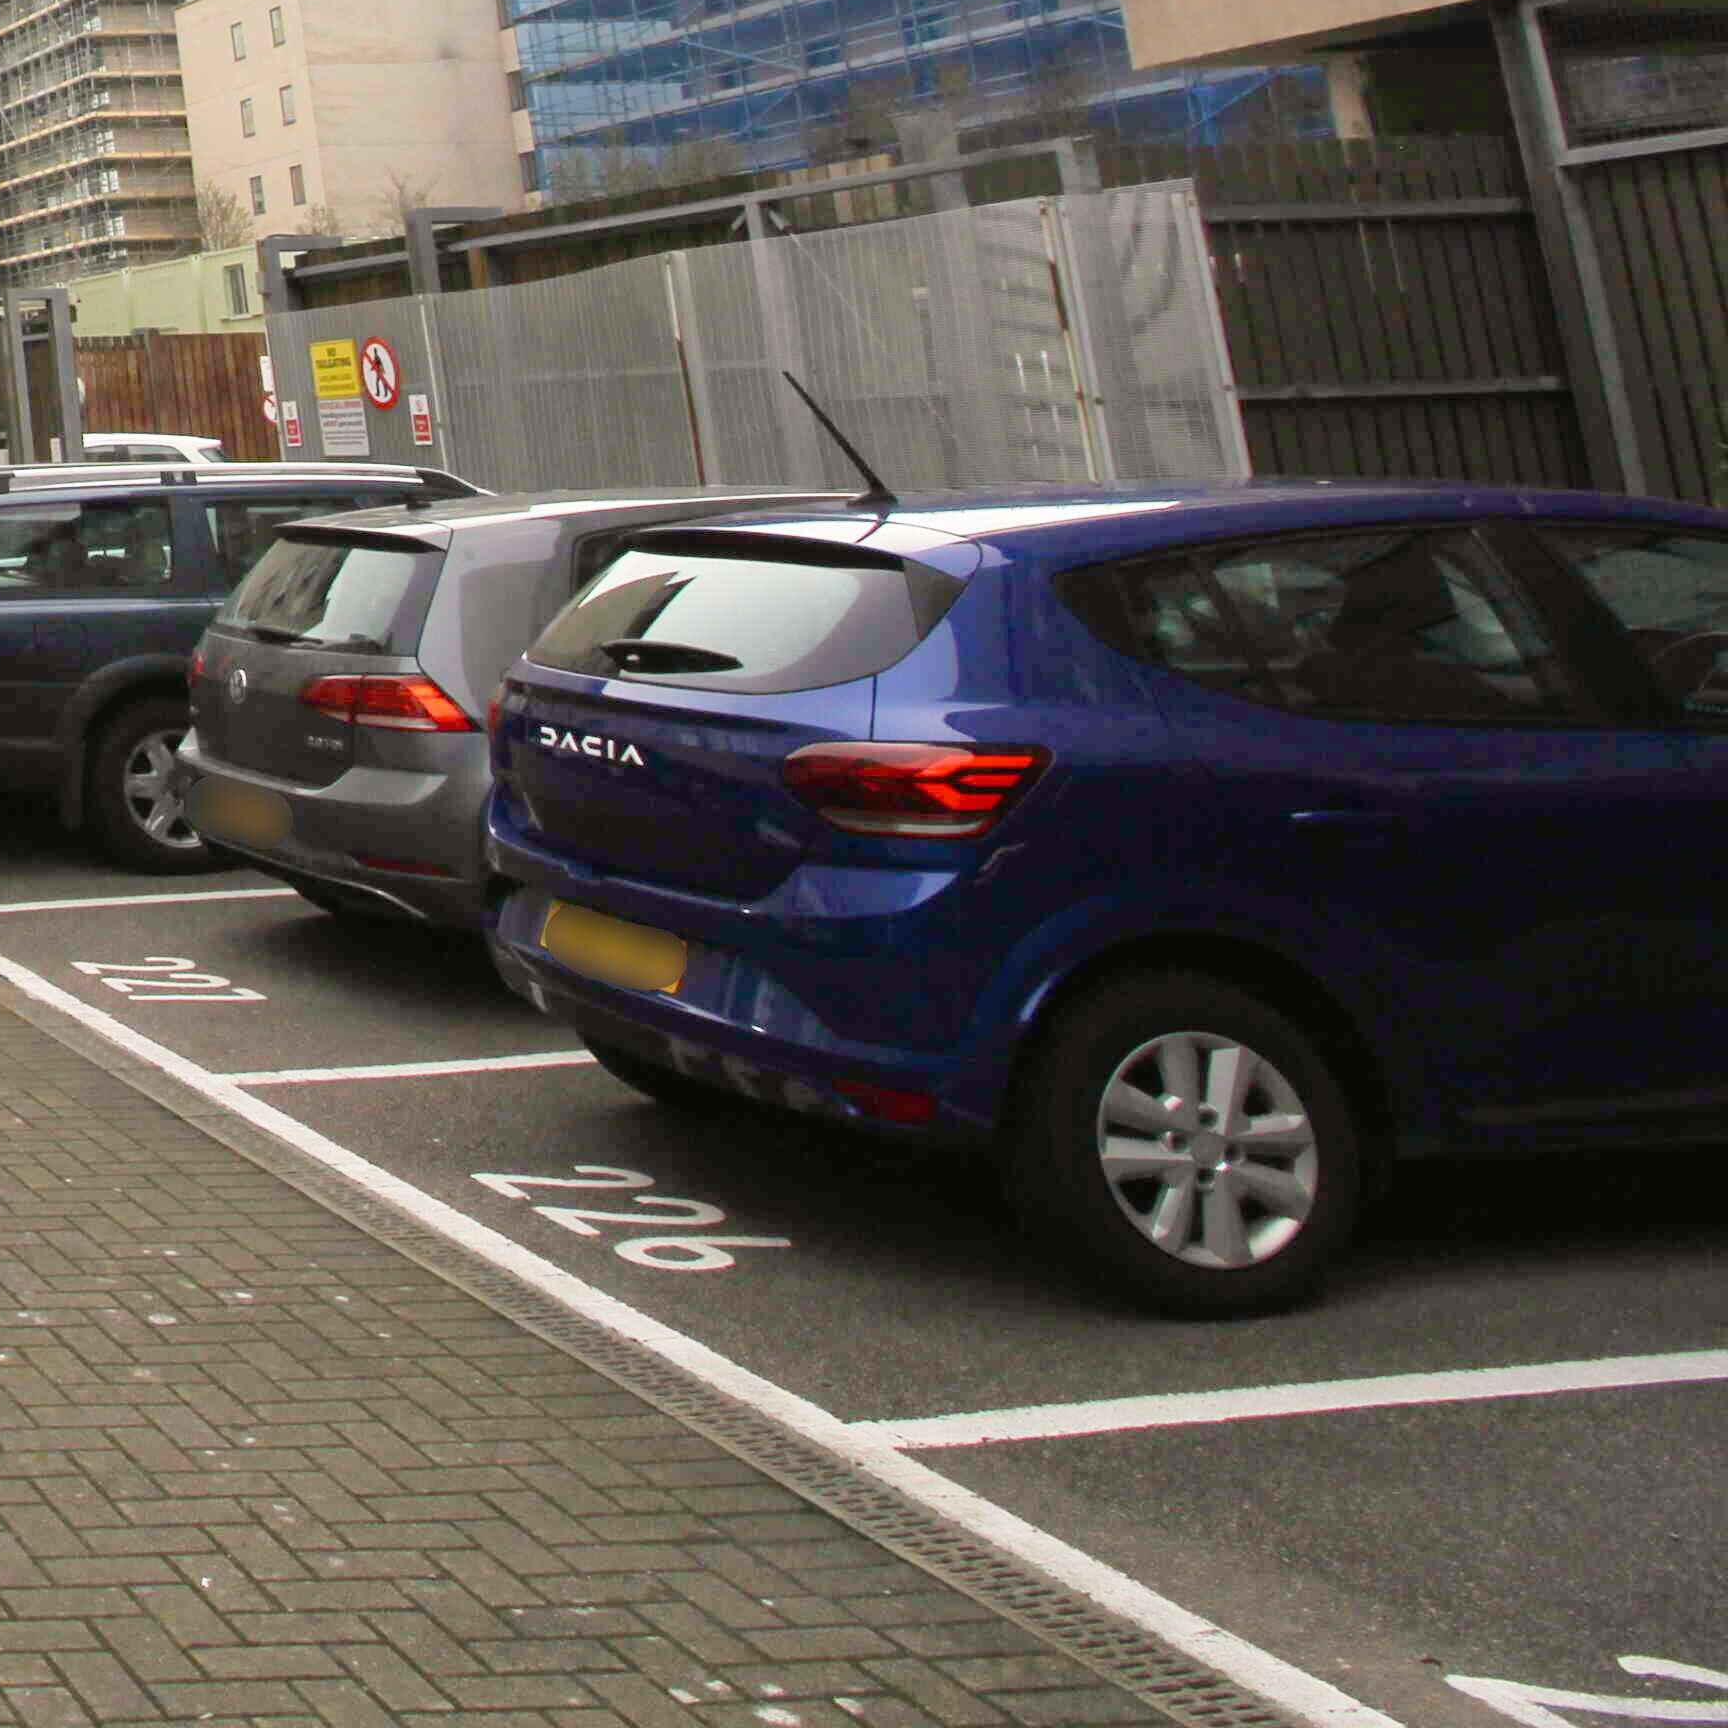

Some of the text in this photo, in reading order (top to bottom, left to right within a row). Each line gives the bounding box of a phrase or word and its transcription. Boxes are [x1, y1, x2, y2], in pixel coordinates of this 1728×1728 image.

[540, 725, 644, 766] DACIA
[70, 955, 269, 1001] 227
[469, 1164, 792, 1272] 226
